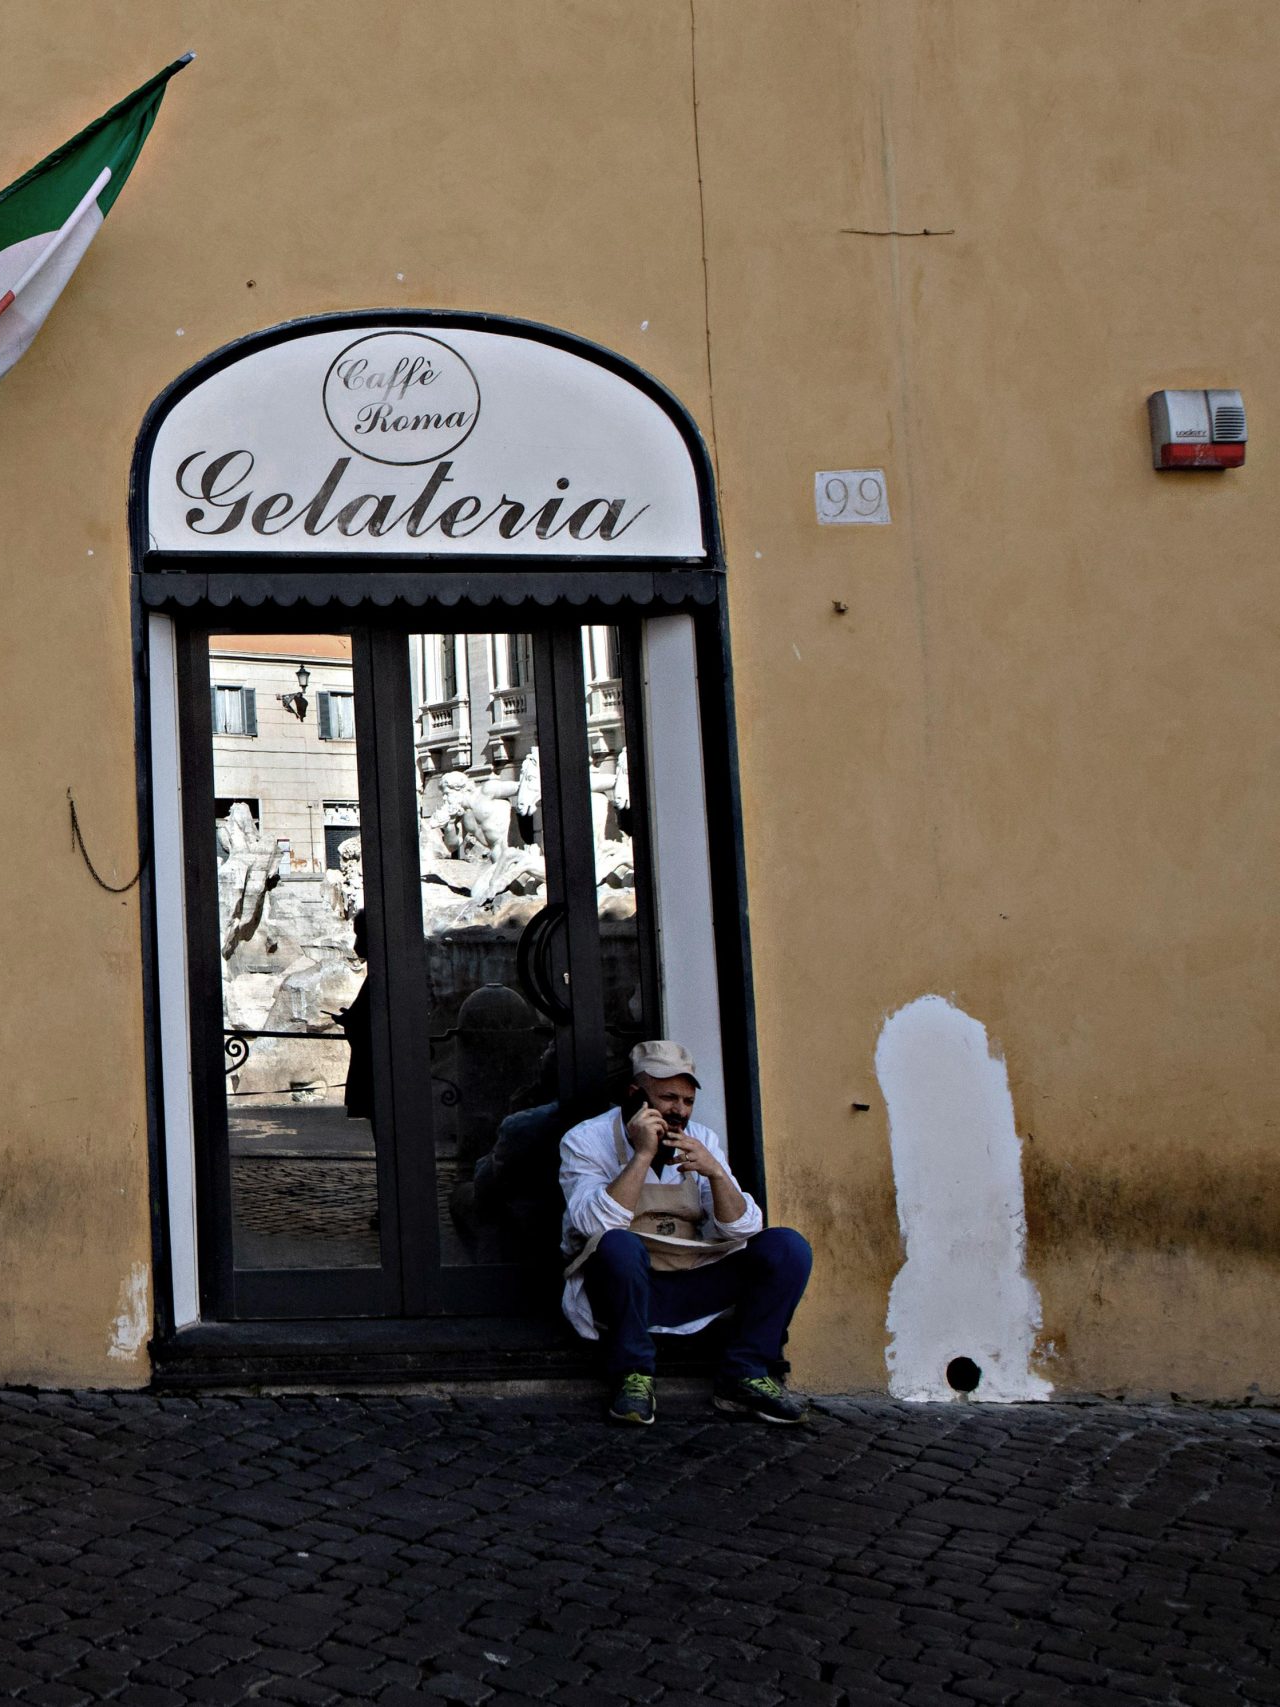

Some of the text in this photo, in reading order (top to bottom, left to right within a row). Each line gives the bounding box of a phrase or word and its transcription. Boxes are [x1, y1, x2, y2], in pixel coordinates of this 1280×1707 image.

[336, 356, 442, 401] Caffè
[354, 402, 475, 435] Roma
[175, 449, 650, 542] Gelateria
[822, 478, 882, 518] 99
